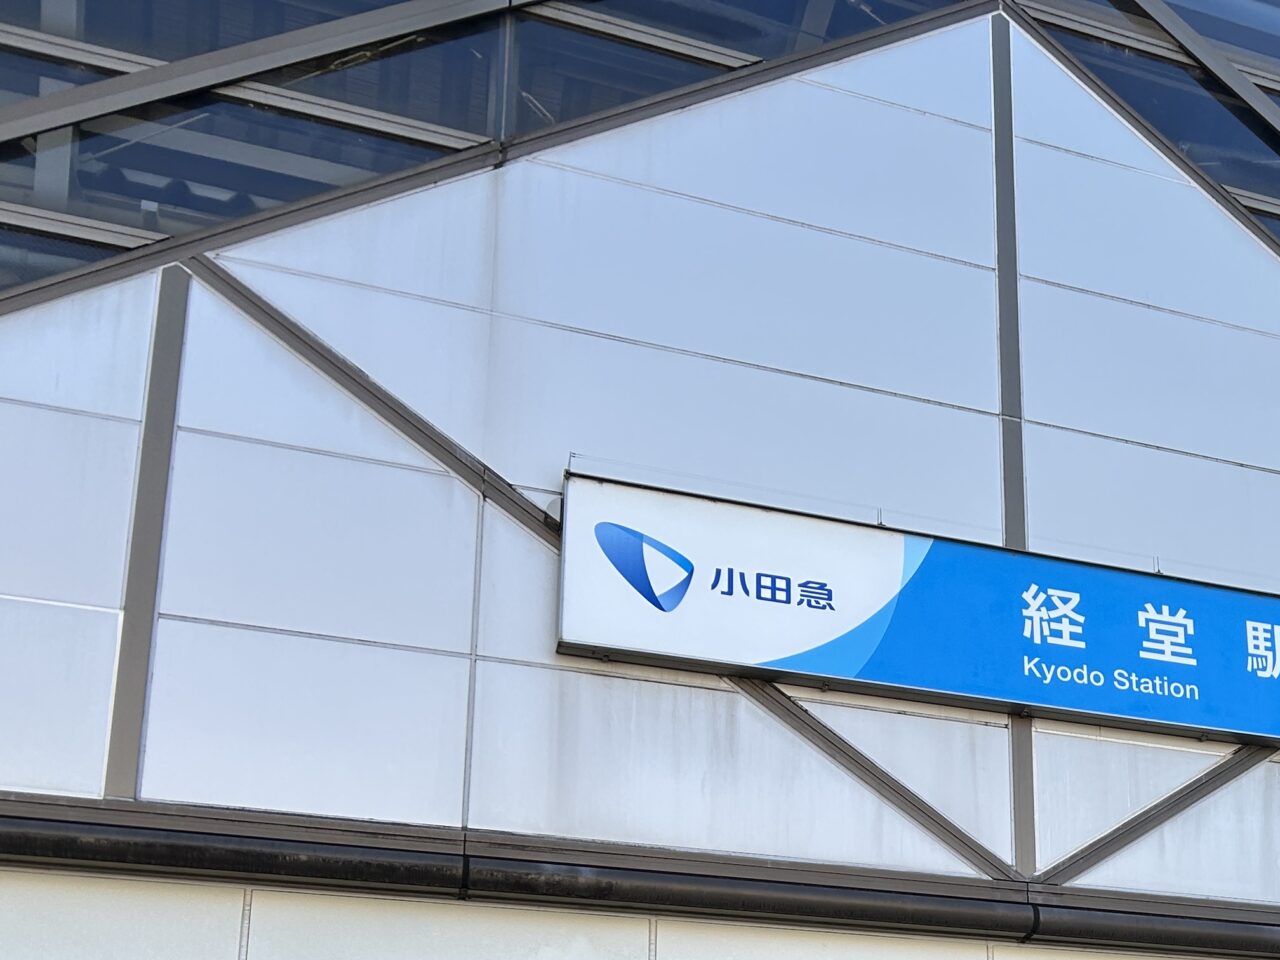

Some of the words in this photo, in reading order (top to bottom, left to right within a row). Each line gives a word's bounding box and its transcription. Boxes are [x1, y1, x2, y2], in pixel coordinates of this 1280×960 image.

[711, 567, 836, 612] 小田急
[1023, 655, 1105, 685] Kyodo
[1113, 669, 1199, 700] Station
